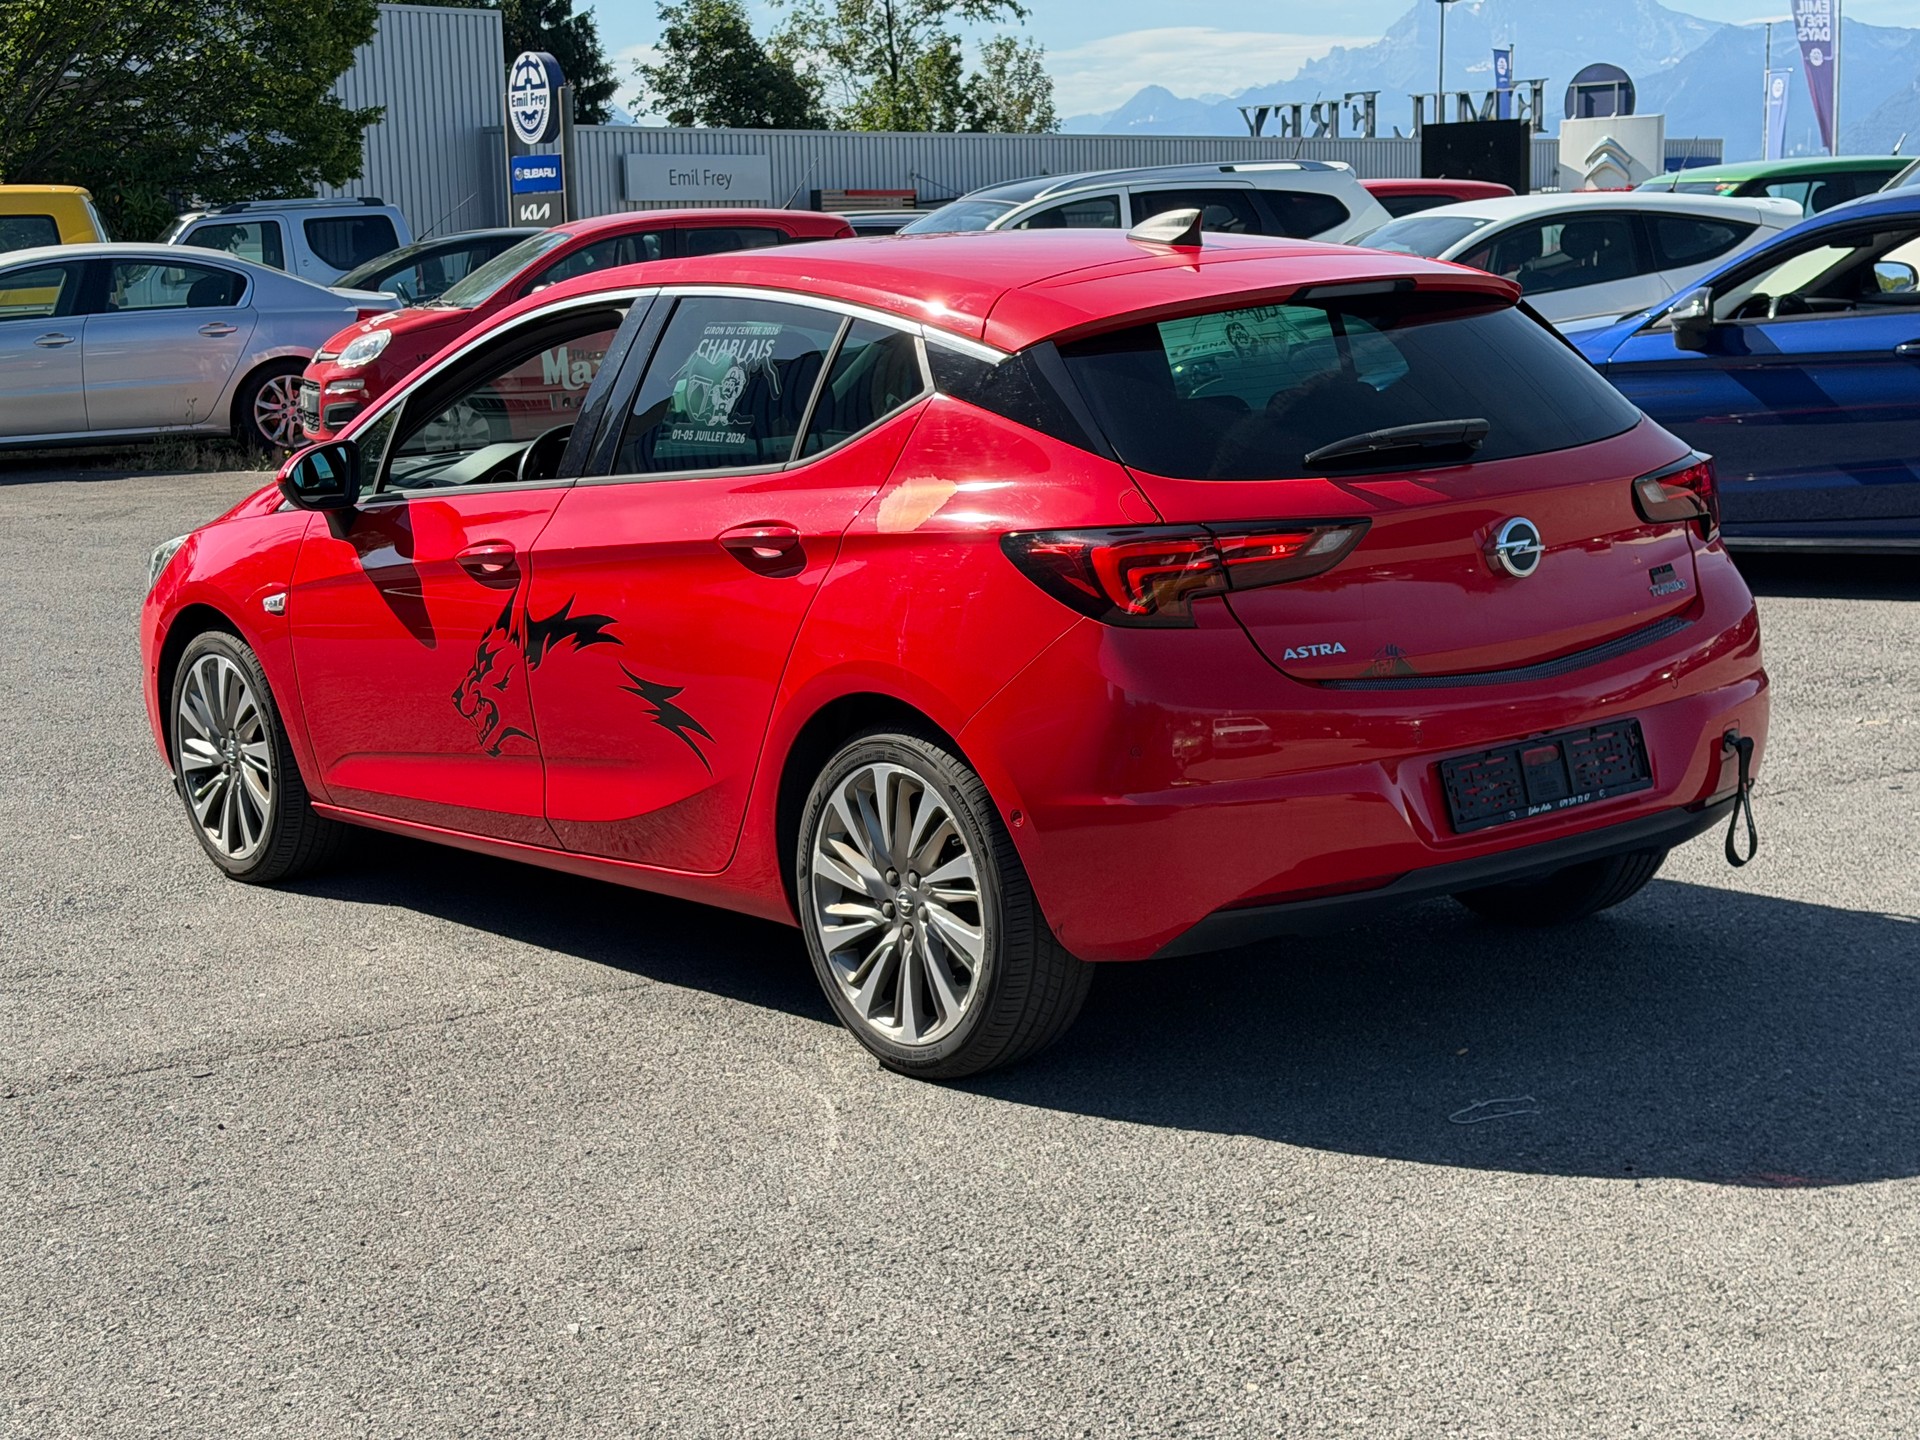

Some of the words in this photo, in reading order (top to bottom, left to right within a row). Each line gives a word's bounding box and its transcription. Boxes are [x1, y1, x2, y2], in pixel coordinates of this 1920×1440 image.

[511, 93, 528, 108] Emil
[530, 92, 547, 108] Frey
[523, 167, 557, 179] SUBARU
[669, 168, 700, 186] Emil
[703, 169, 733, 190] Frey
[704, 326, 725, 335] GIRON
[725, 326, 736, 335] DU
[736, 326, 762, 336] CENTRE
[762, 326, 779, 336] 2026
[697, 338, 776, 363] CHABLAIS
[672, 429, 695, 441] 01-05
[694, 430, 726, 443] JUILLET
[726, 431, 746, 444] 2026
[1283, 641, 1347, 661] ASTRA
